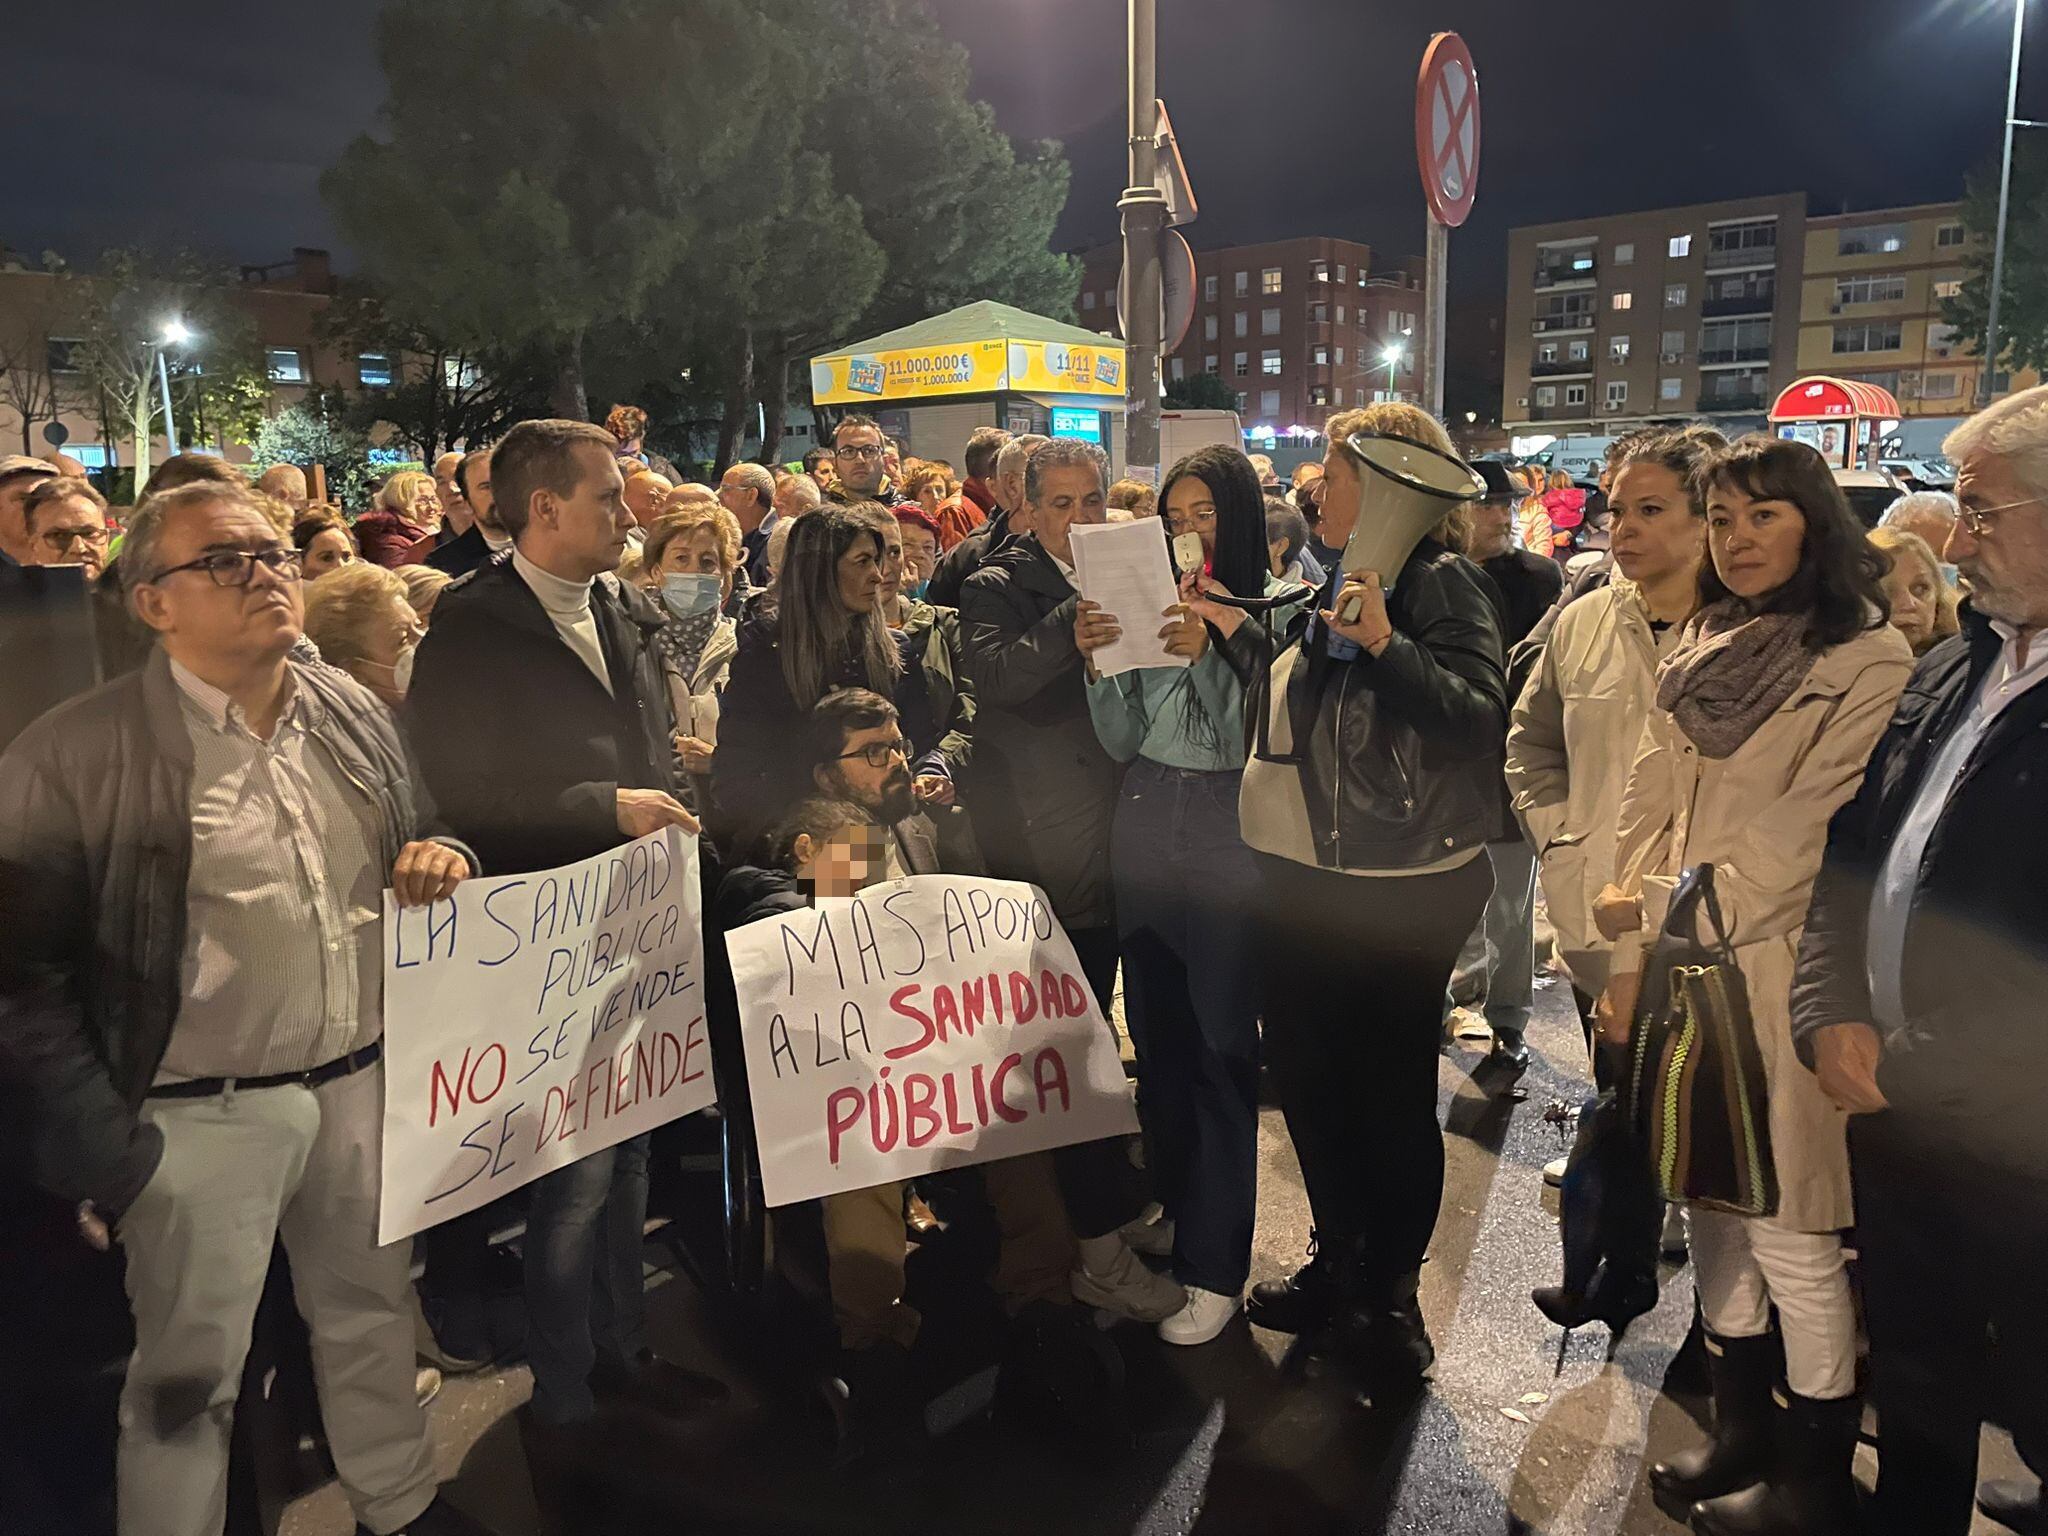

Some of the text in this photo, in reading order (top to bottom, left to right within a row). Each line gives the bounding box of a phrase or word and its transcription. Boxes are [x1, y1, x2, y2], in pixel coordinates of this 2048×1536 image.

[1057, 353, 1090, 371] 11/11
[396, 840, 670, 968] LA SANIDAD
[537, 904, 679, 1015] PÚBLICA
[780, 888, 1052, 996] MAS APOYO
[429, 961, 695, 1128] NO SE VENDE
[769, 970, 1088, 1078] A LA SANIDAD
[425, 1016, 705, 1204] SE DEFIENDE
[827, 1047, 1070, 1165] PÚBLICA
